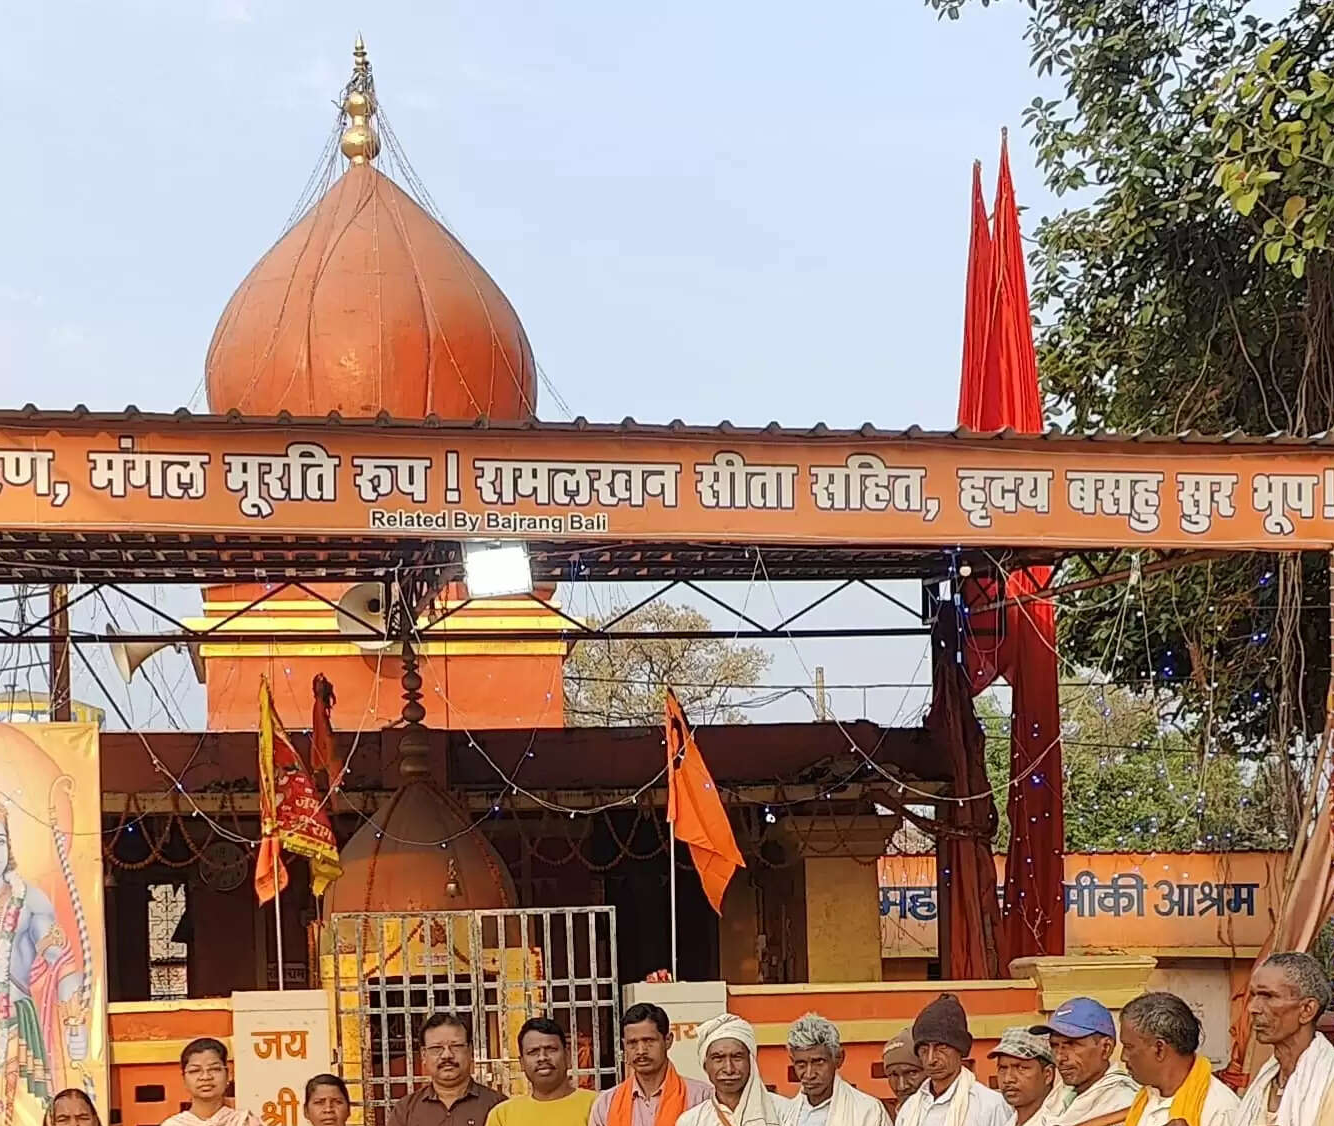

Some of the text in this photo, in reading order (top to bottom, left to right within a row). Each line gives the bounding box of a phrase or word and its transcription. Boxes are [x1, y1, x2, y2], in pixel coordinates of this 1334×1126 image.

[88, 436, 209, 499] मंगल
[224, 443, 340, 518] मूरति
[353, 457, 431, 503] रूप
[473, 459, 681, 508] रामलखन
[695, 451, 798, 511] सीता
[810, 453, 941, 521] सहित,
[957, 468, 1053, 527] हृदय
[1065, 470, 1163, 533] बसहु
[1176, 473, 1238, 534] सुर
[371, 511, 607, 533] Related By Bajrang Bali
[1154, 880, 1259, 917] आश्रम
[251, 1031, 308, 1060] जय
